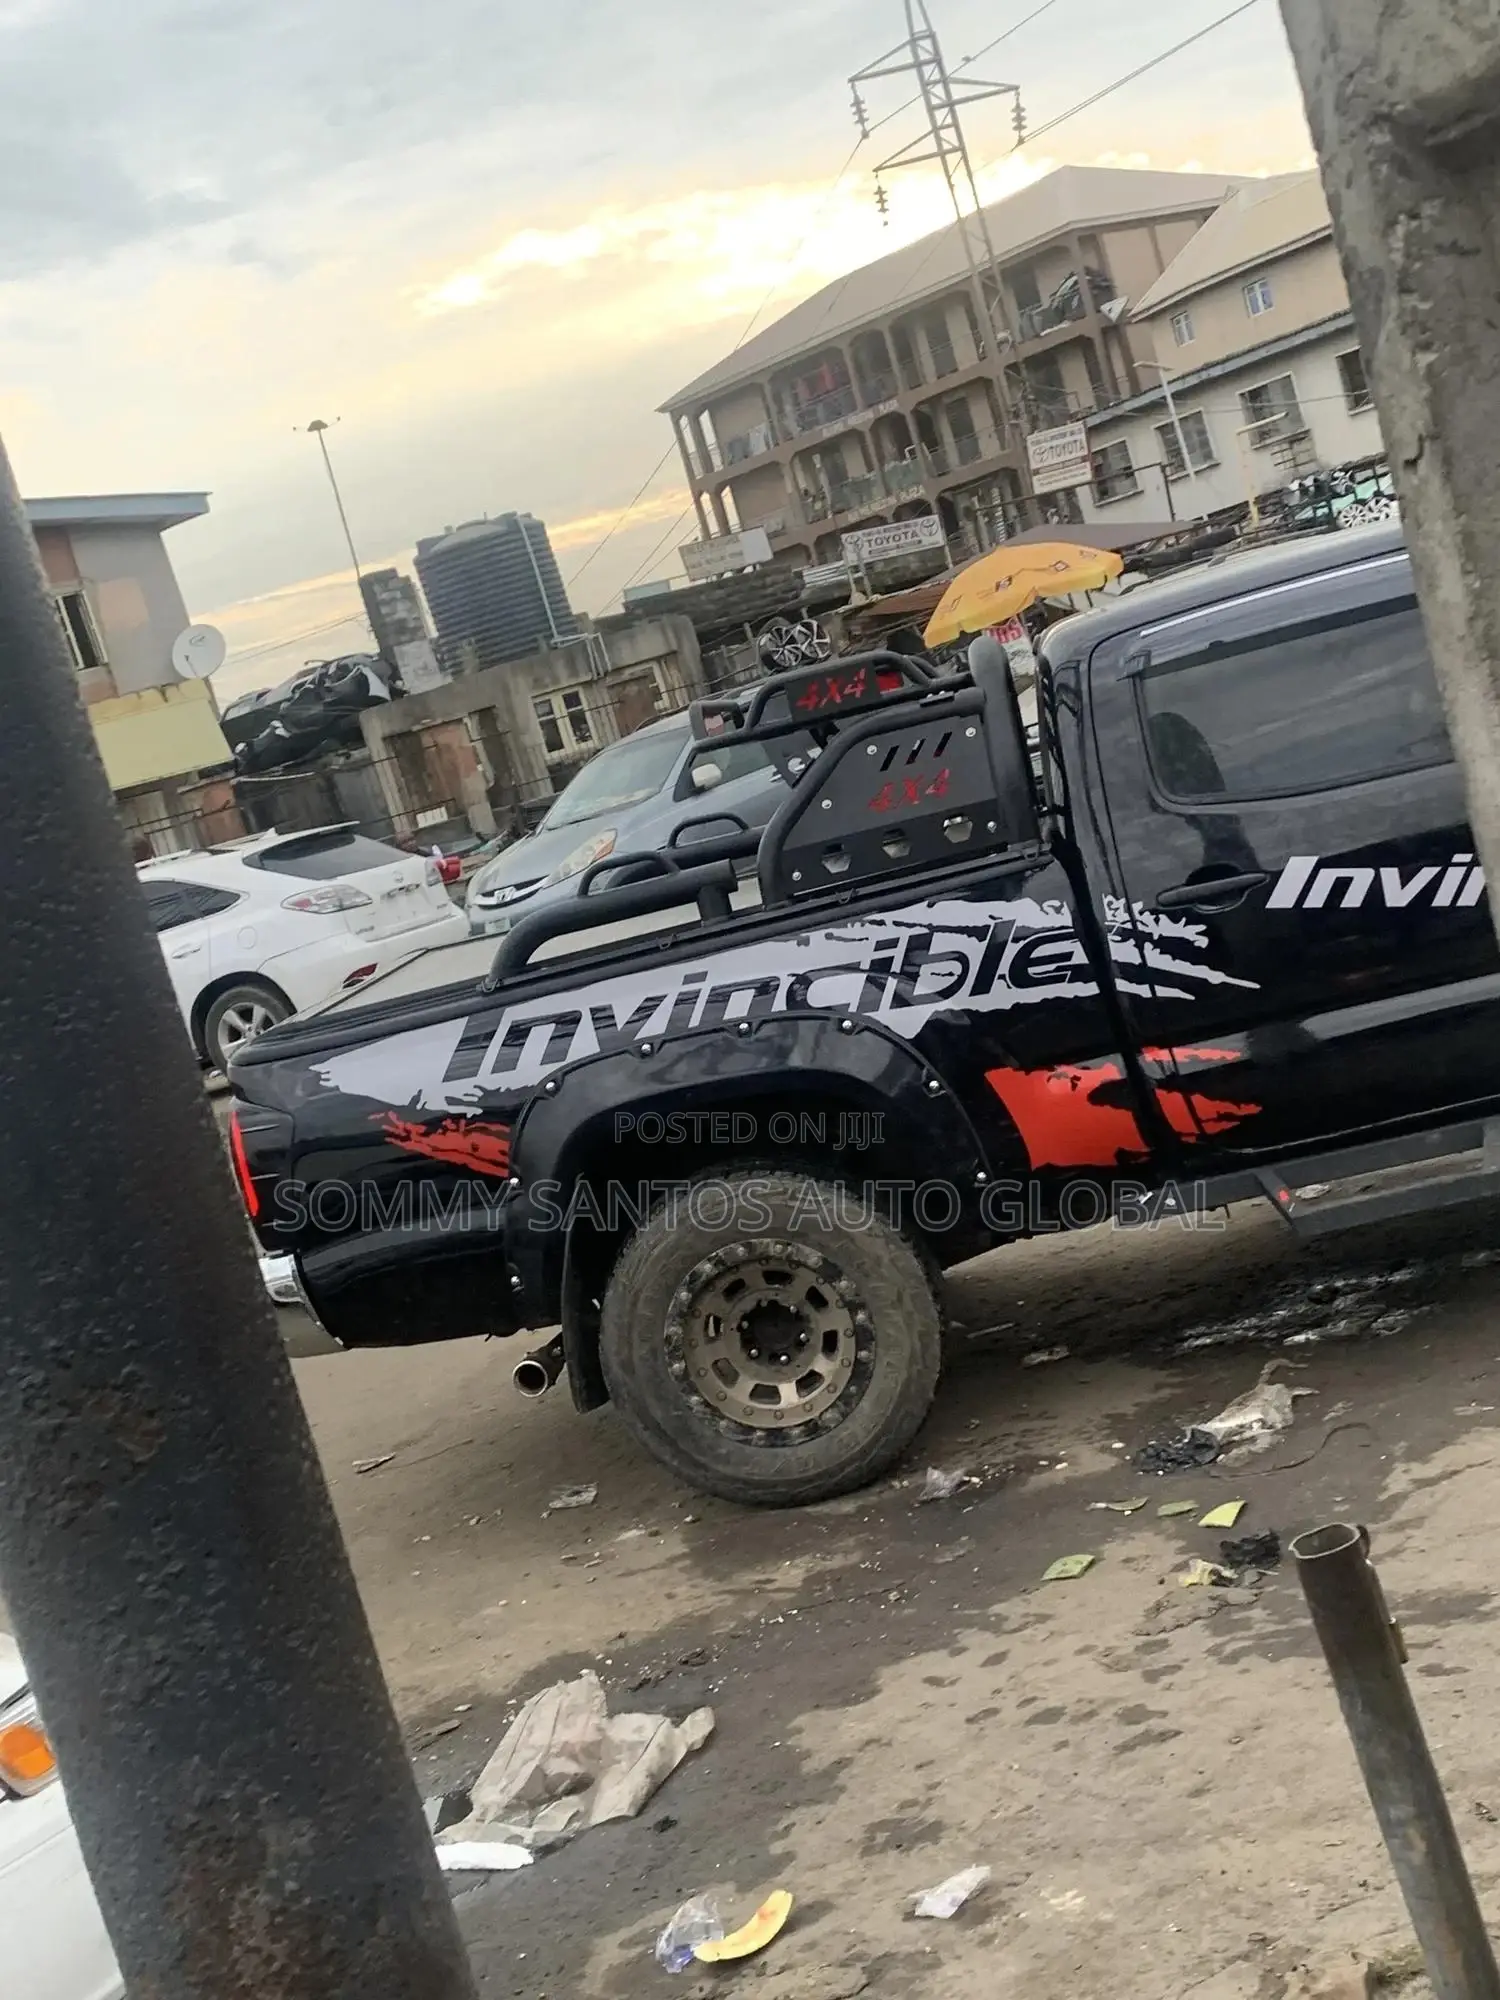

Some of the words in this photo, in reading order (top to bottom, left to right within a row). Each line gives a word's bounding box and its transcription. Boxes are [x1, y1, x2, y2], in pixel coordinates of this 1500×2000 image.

[1049, 438, 1085, 461] TOYOTA
[867, 529, 921, 548] TOYOTA
[442, 918, 1092, 1082] Invincible
